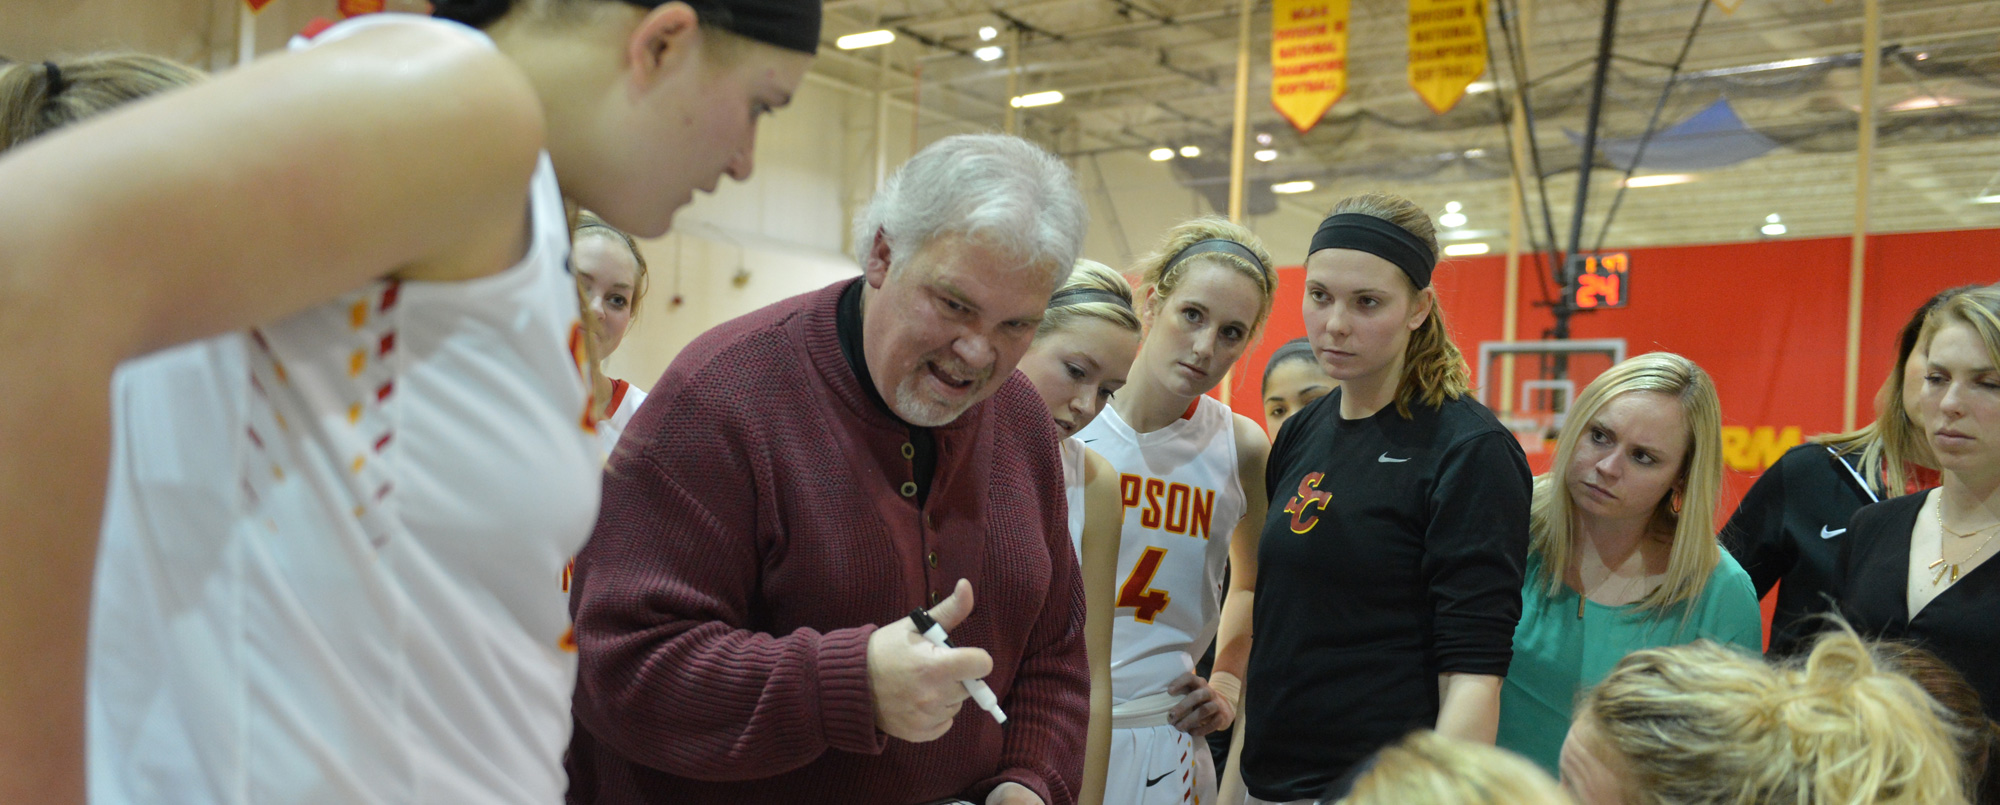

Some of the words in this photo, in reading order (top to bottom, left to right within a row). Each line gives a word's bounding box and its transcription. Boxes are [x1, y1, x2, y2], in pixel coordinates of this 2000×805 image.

[1415, 24, 1475, 41] NATIONAL
[1280, 43, 1336, 58] NATIONAL
[1408, 43, 1482, 62] CHAMPIONS
[1273, 59, 1345, 76] CHAMPIONS
[1413, 64, 1473, 81] SOFTBALL
[1278, 79, 1336, 95] SOFTBALL
[1576, 273, 1620, 308] 24
[1120, 472, 1216, 541] PSON
[1115, 545, 1172, 625] 4
